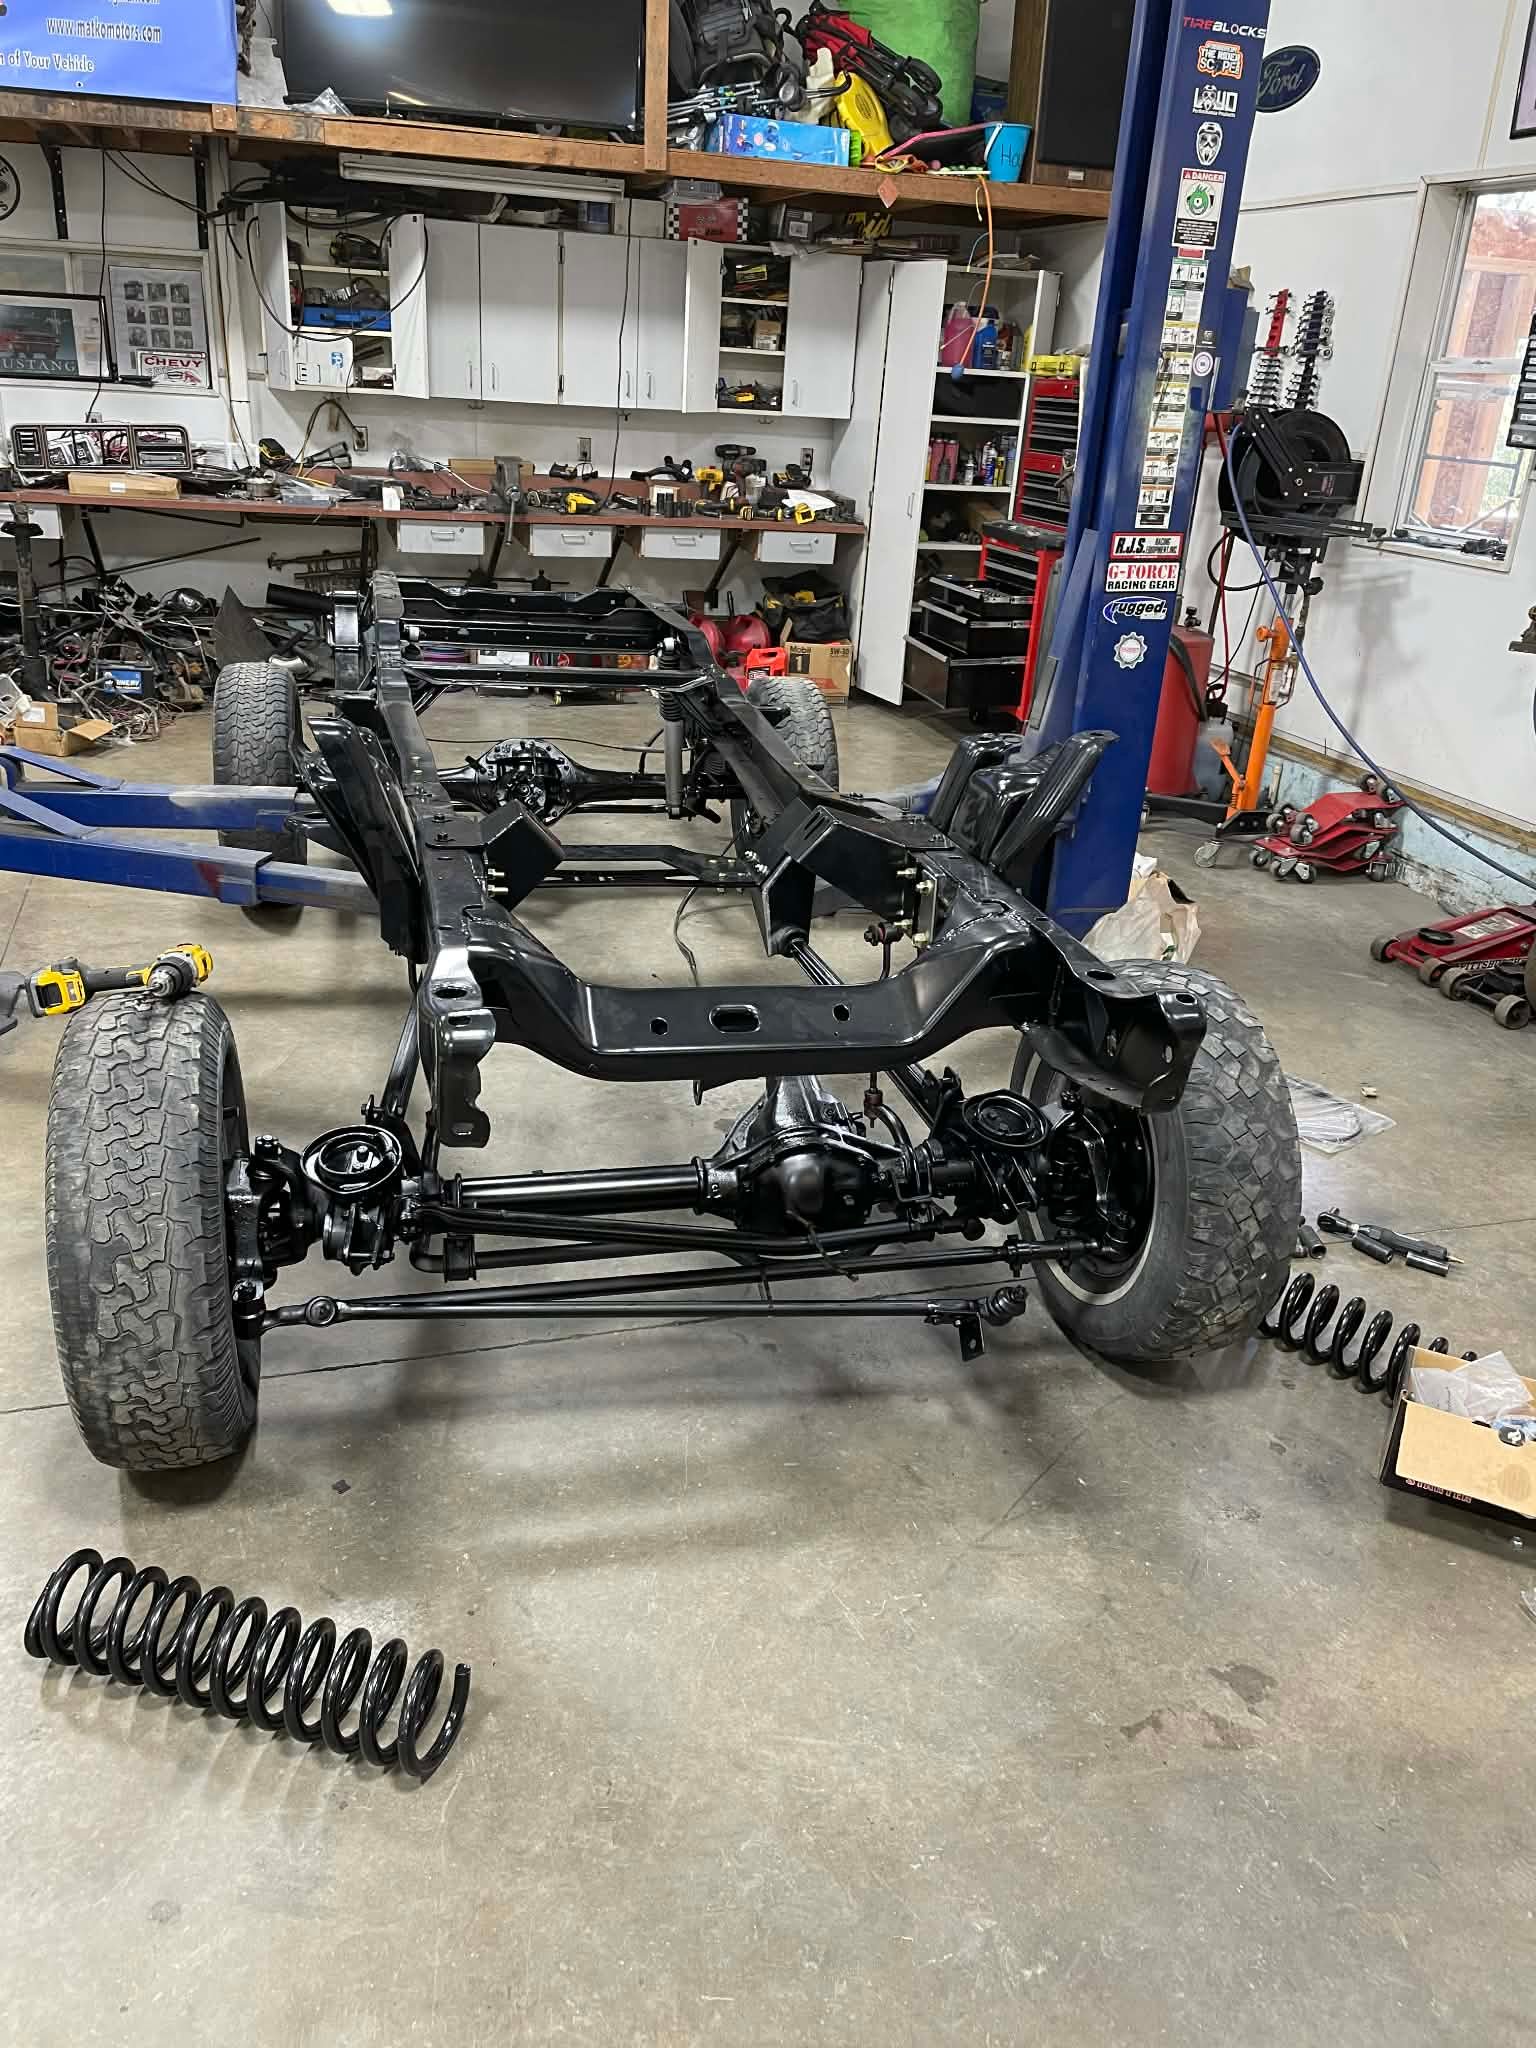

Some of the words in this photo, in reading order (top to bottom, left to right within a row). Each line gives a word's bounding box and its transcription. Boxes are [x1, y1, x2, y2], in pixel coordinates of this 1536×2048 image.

[47, 18, 161, 43] www.matkomotors.com
[1183, 16, 1267, 39] TIREBLOCKS
[9, 48, 21, 66] of
[23, 50, 50, 69] Your
[52, 52, 95, 72] Vehicle
[1256, 55, 1306, 98] Ford
[1191, 172, 1224, 182] DANGER
[144, 356, 202, 368] CHEVY
[1108, 564, 1177, 580] G-FORCE
[1107, 580, 1147, 591] RACING
[1148, 580, 1176, 590] GEAR
[790, 646, 811, 654] Mobil
